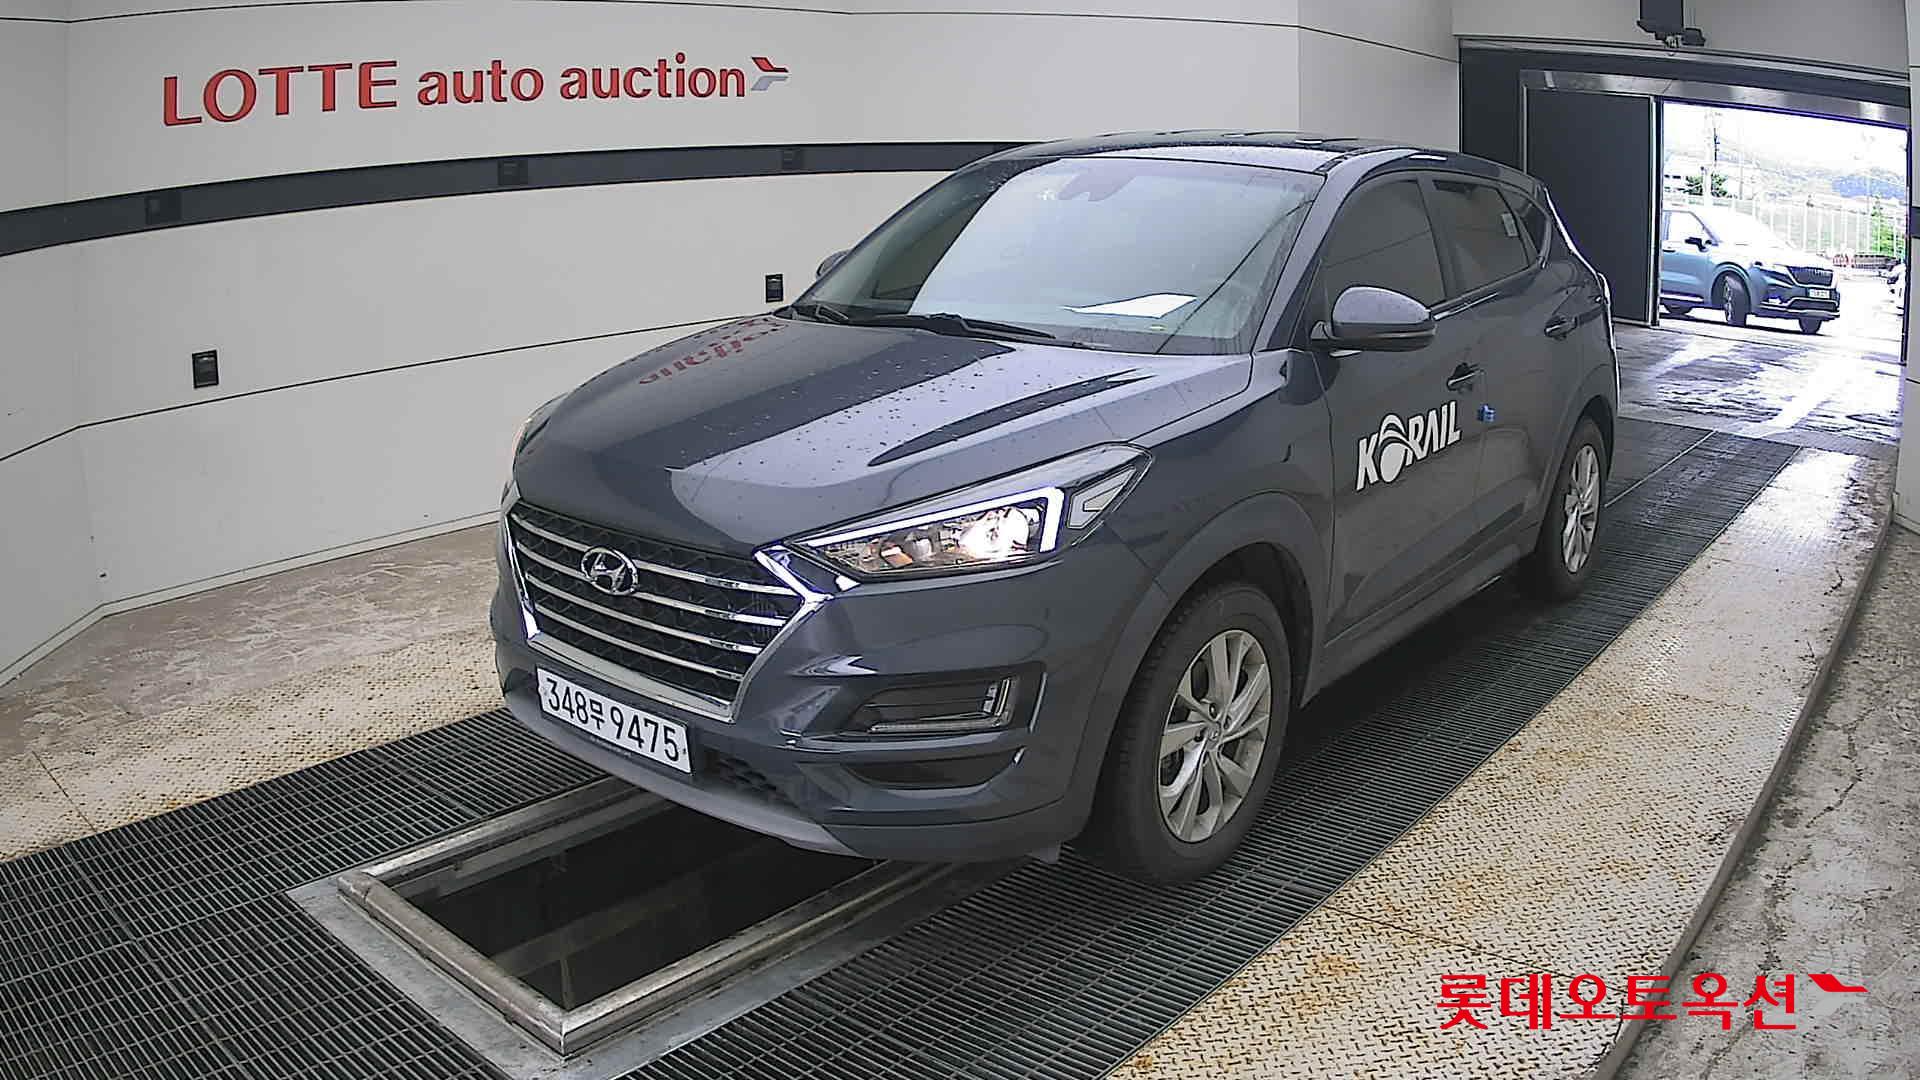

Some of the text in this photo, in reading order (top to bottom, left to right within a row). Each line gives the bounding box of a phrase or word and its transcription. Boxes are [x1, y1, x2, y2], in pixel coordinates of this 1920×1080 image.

[163, 52, 746, 127] LOTTE auto auction
[1356, 400, 1462, 491] KORAIL
